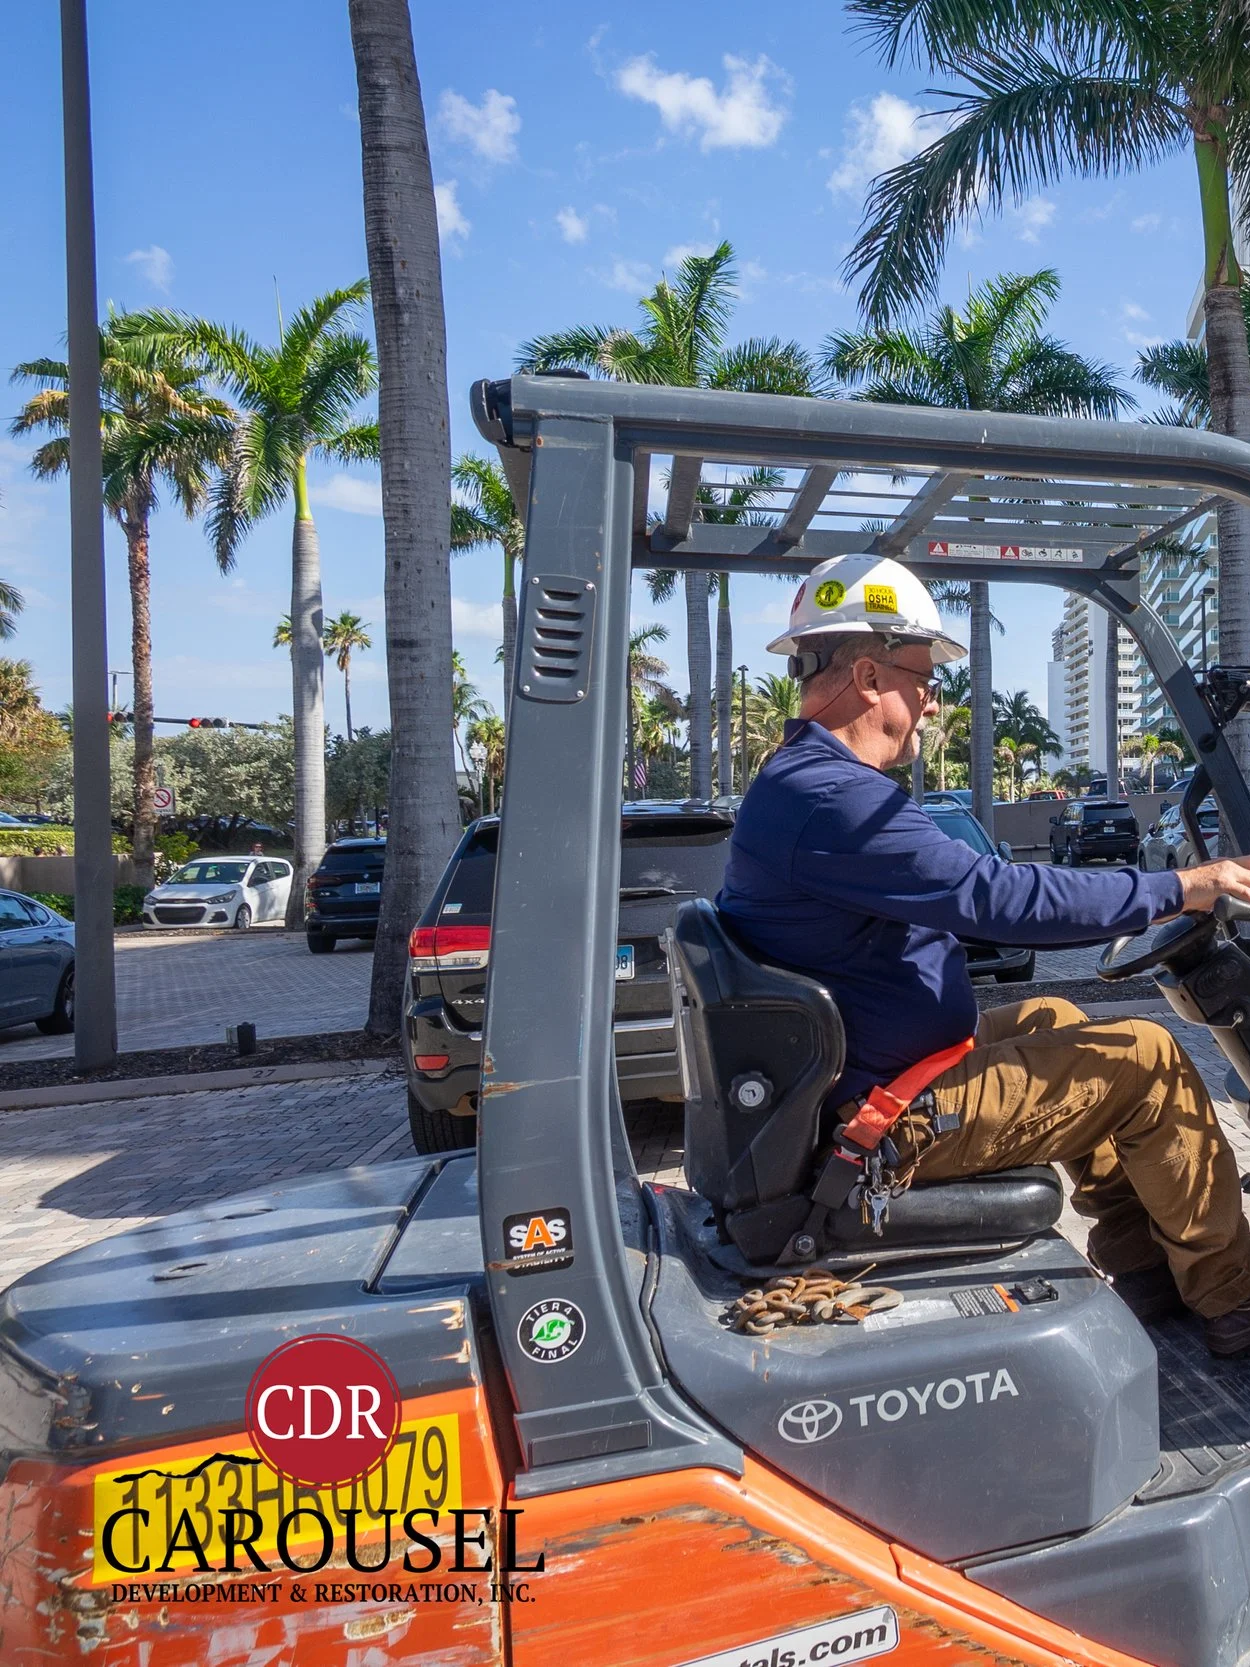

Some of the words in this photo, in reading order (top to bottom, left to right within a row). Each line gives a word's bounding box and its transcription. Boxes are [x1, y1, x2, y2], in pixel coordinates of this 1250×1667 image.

[868, 593, 894, 604] OSHA
[868, 602, 895, 612] TRAINED
[252, 1069, 277, 1079] 27
[509, 1216, 567, 1251] SAS
[513, 1252, 536, 1261] SYSTEM
[545, 1248, 566, 1256] ACTIVE
[525, 1302, 560, 1323] TIER
[564, 1306, 574, 1316] 4
[531, 1338, 578, 1360] FINAL
[849, 1368, 1019, 1427] TOYOTA
[740, 1624, 888, 1667] ls.com
